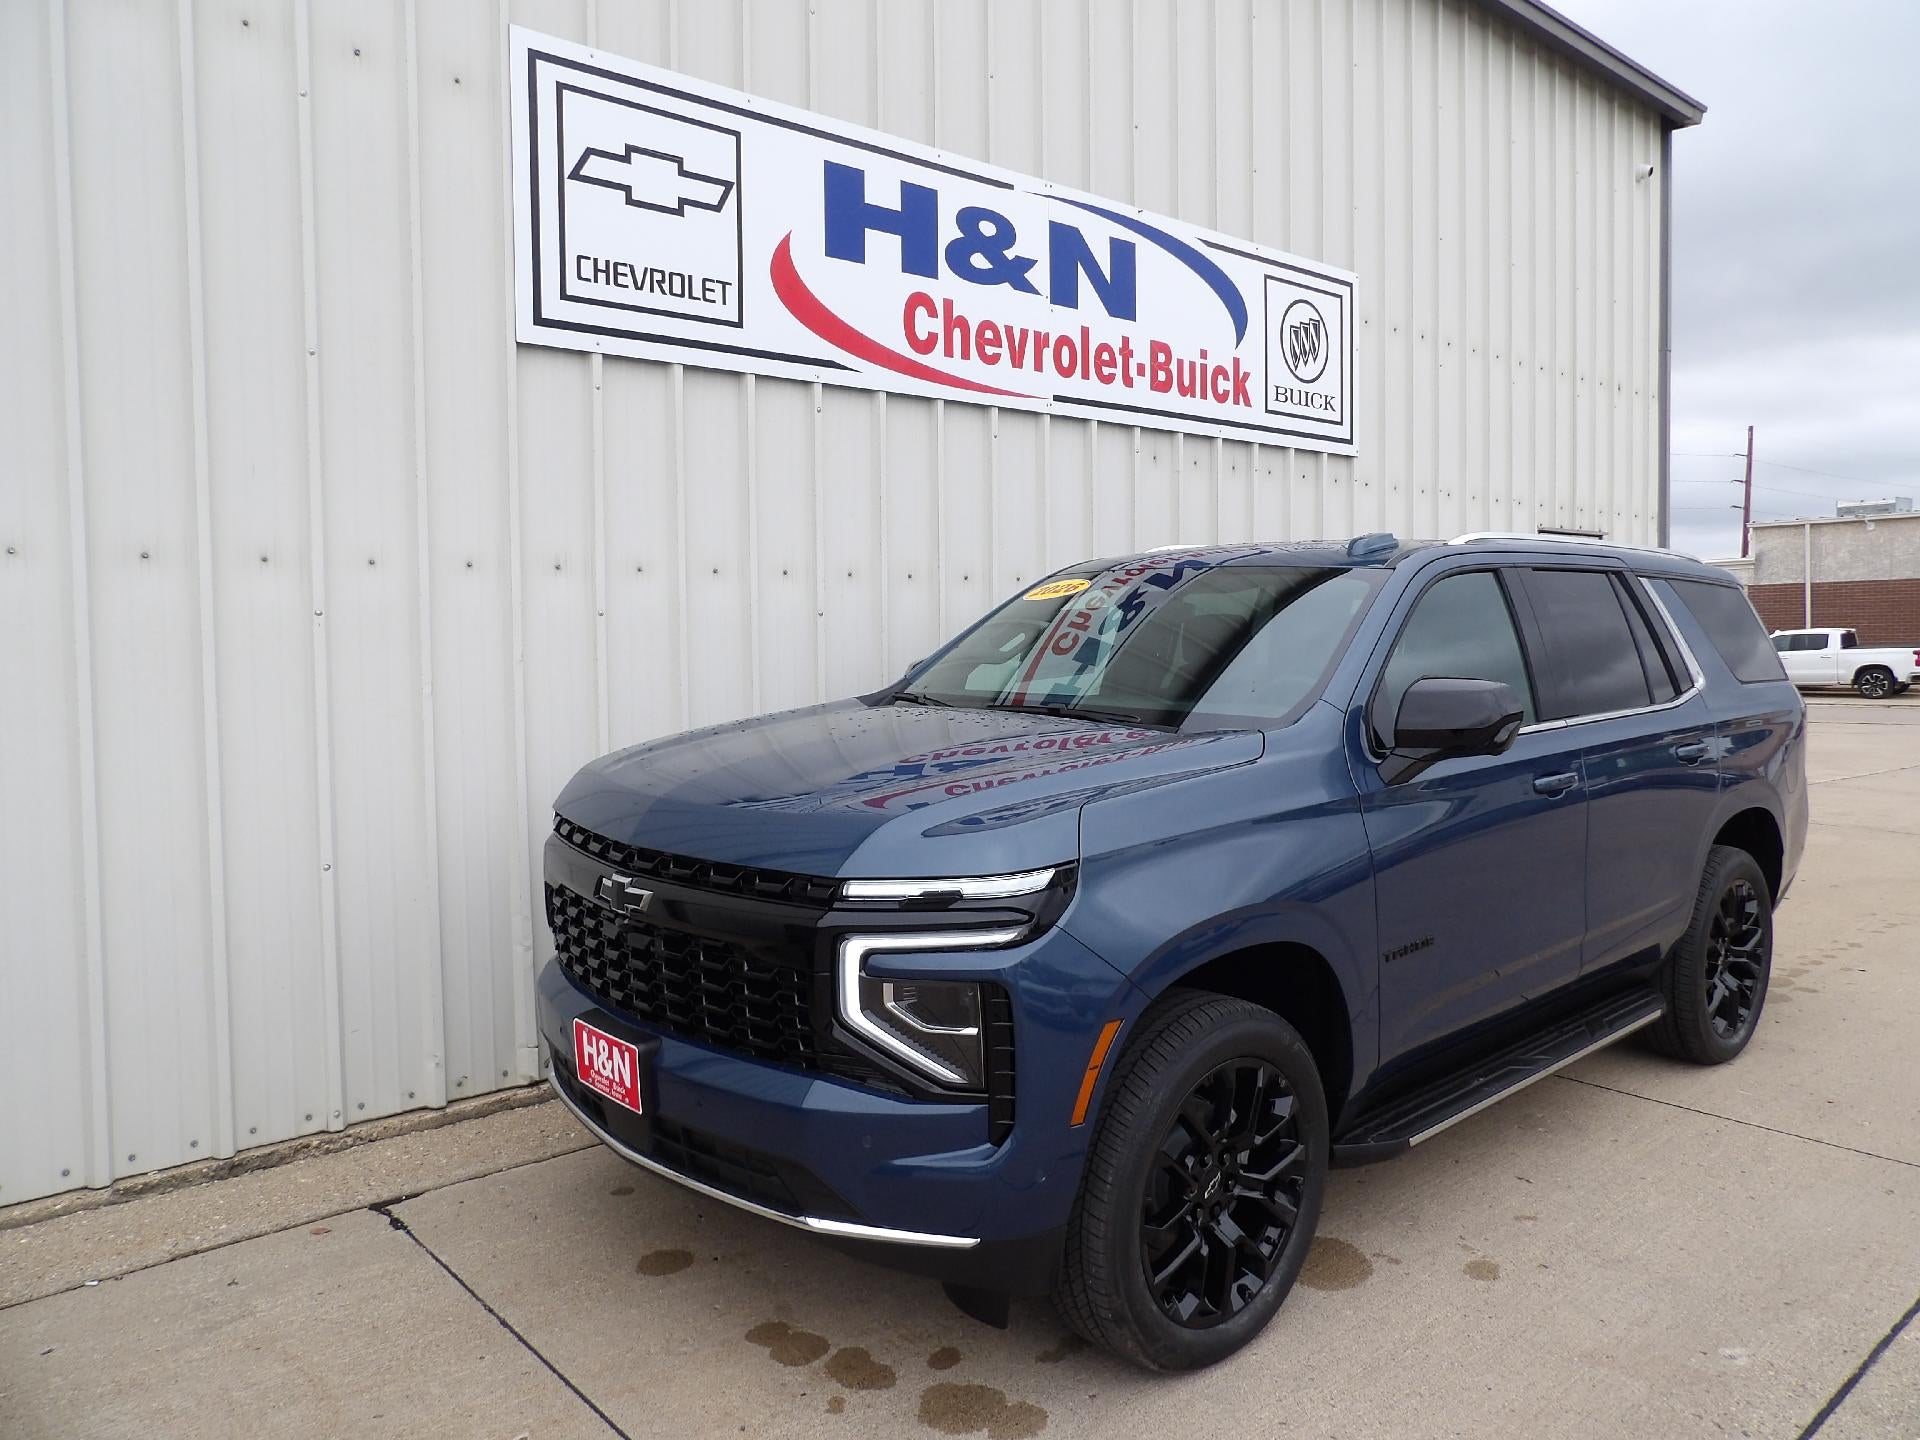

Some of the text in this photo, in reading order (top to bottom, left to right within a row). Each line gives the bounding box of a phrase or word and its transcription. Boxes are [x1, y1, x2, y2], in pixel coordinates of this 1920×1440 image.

[824, 159, 1137, 322] H&N
[576, 254, 733, 306] CHEVROLET
[903, 291, 1253, 408] Chevrolet-Buick
[1273, 384, 1337, 412] BUICK
[582, 1030, 632, 1088] H&N
